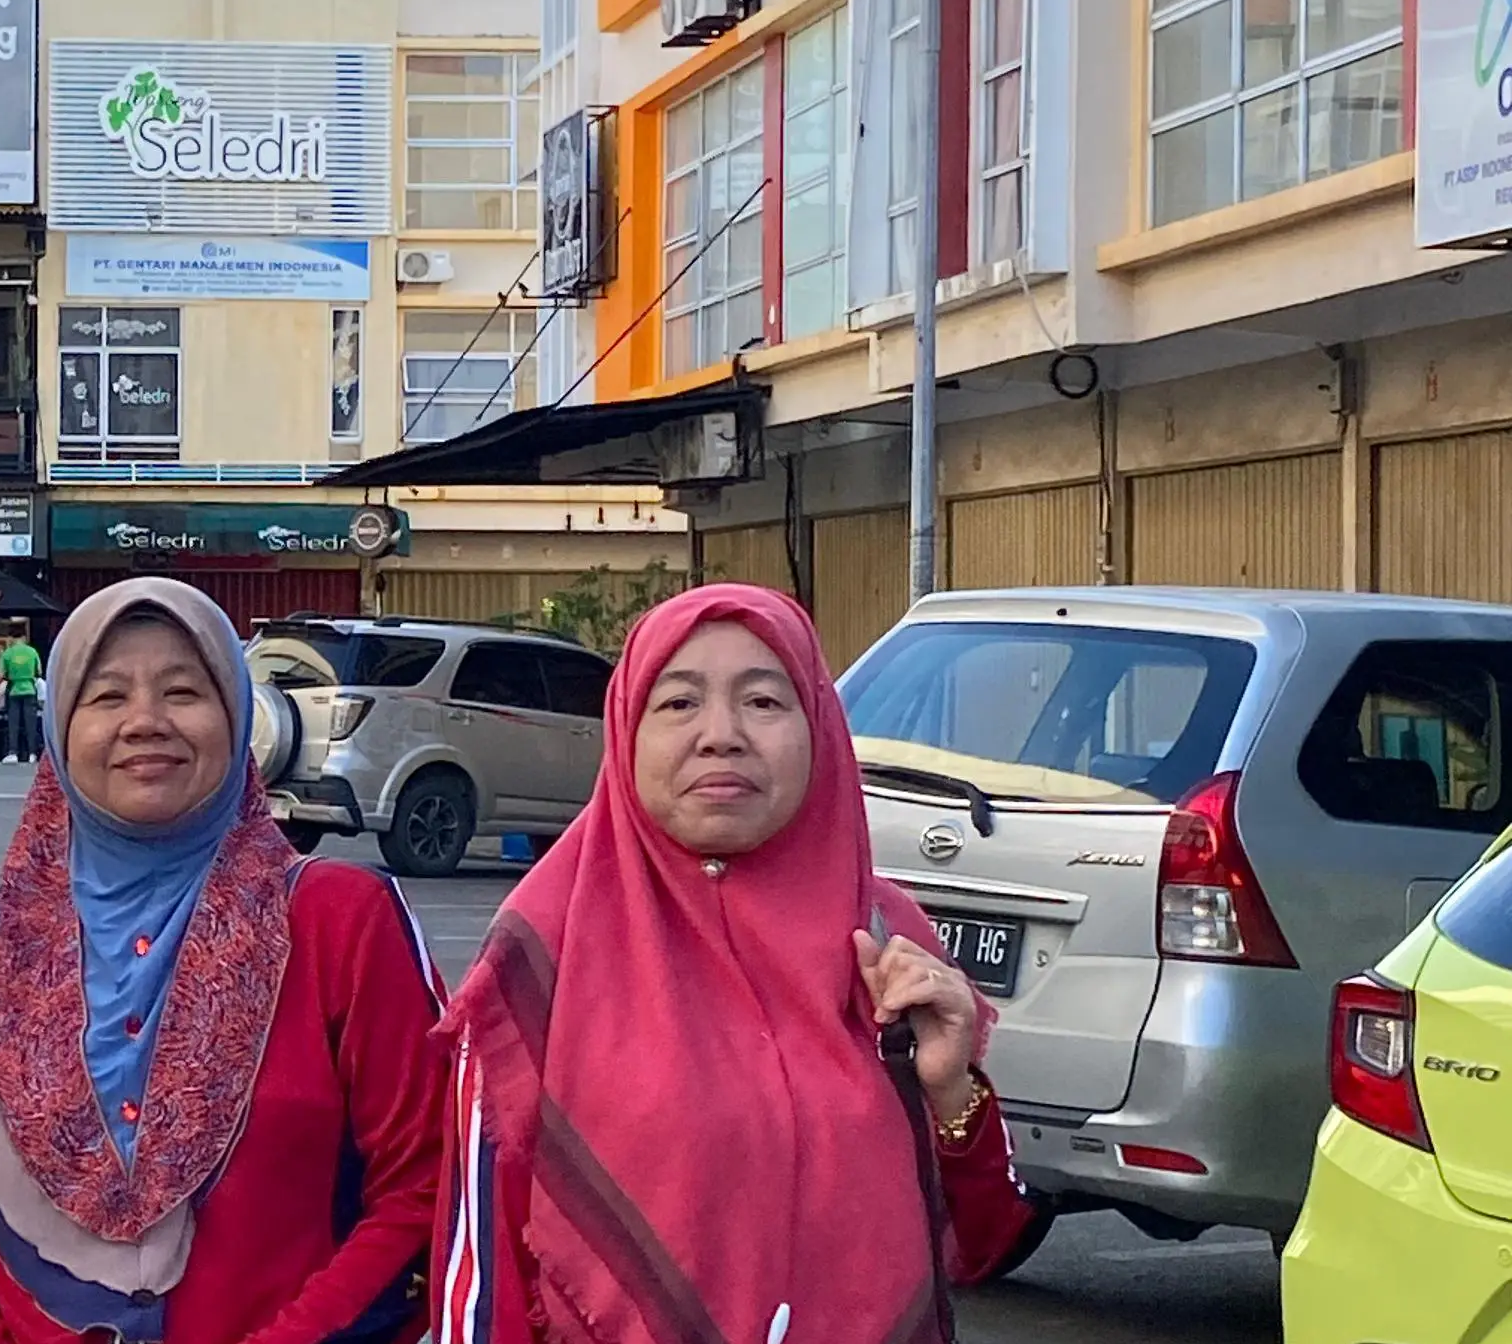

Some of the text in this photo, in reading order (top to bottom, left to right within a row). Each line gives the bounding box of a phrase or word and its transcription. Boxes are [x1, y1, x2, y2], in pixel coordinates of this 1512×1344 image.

[138, 112, 321, 174] Seledri
[117, 260, 175, 271] GENTARI
[179, 260, 264, 272] MANAJEMEN
[268, 262, 342, 273] INDONESIA
[116, 530, 205, 550] Seledri
[268, 532, 349, 551] Seledr
[975, 927, 1007, 965] HG
[1424, 1056, 1501, 1082] BRIO
